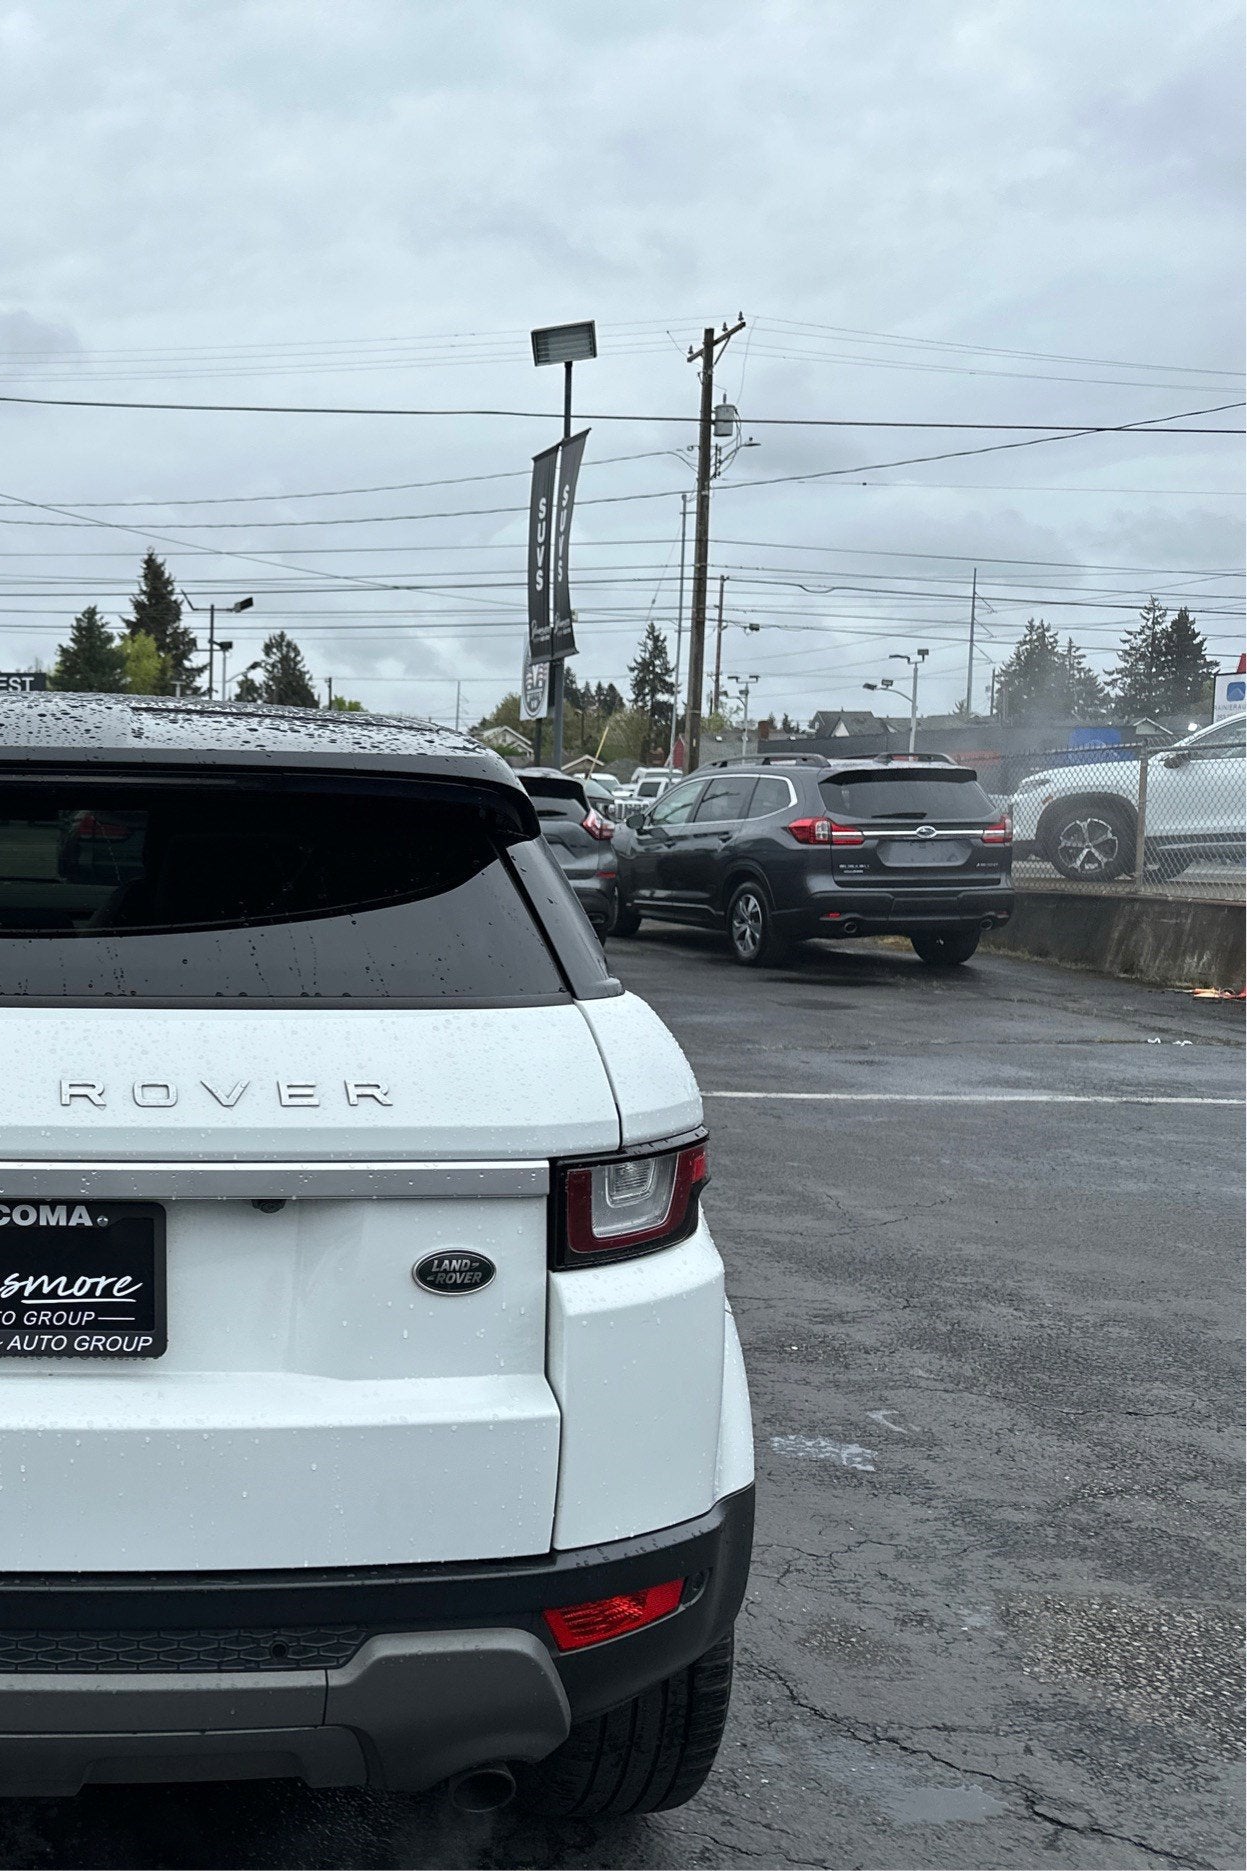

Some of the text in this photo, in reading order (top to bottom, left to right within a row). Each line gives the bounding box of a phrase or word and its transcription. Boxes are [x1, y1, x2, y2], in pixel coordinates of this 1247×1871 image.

[535, 497, 547, 592] SUVS
[558, 484, 570, 583] SUVS
[59, 1078, 394, 1108] ROVER
[434, 1271, 482, 1284] ROVER
[23, 1311, 95, 1326] GROUP
[7, 1335, 68, 1351] AUTO
[73, 1335, 152, 1352] GROUP
